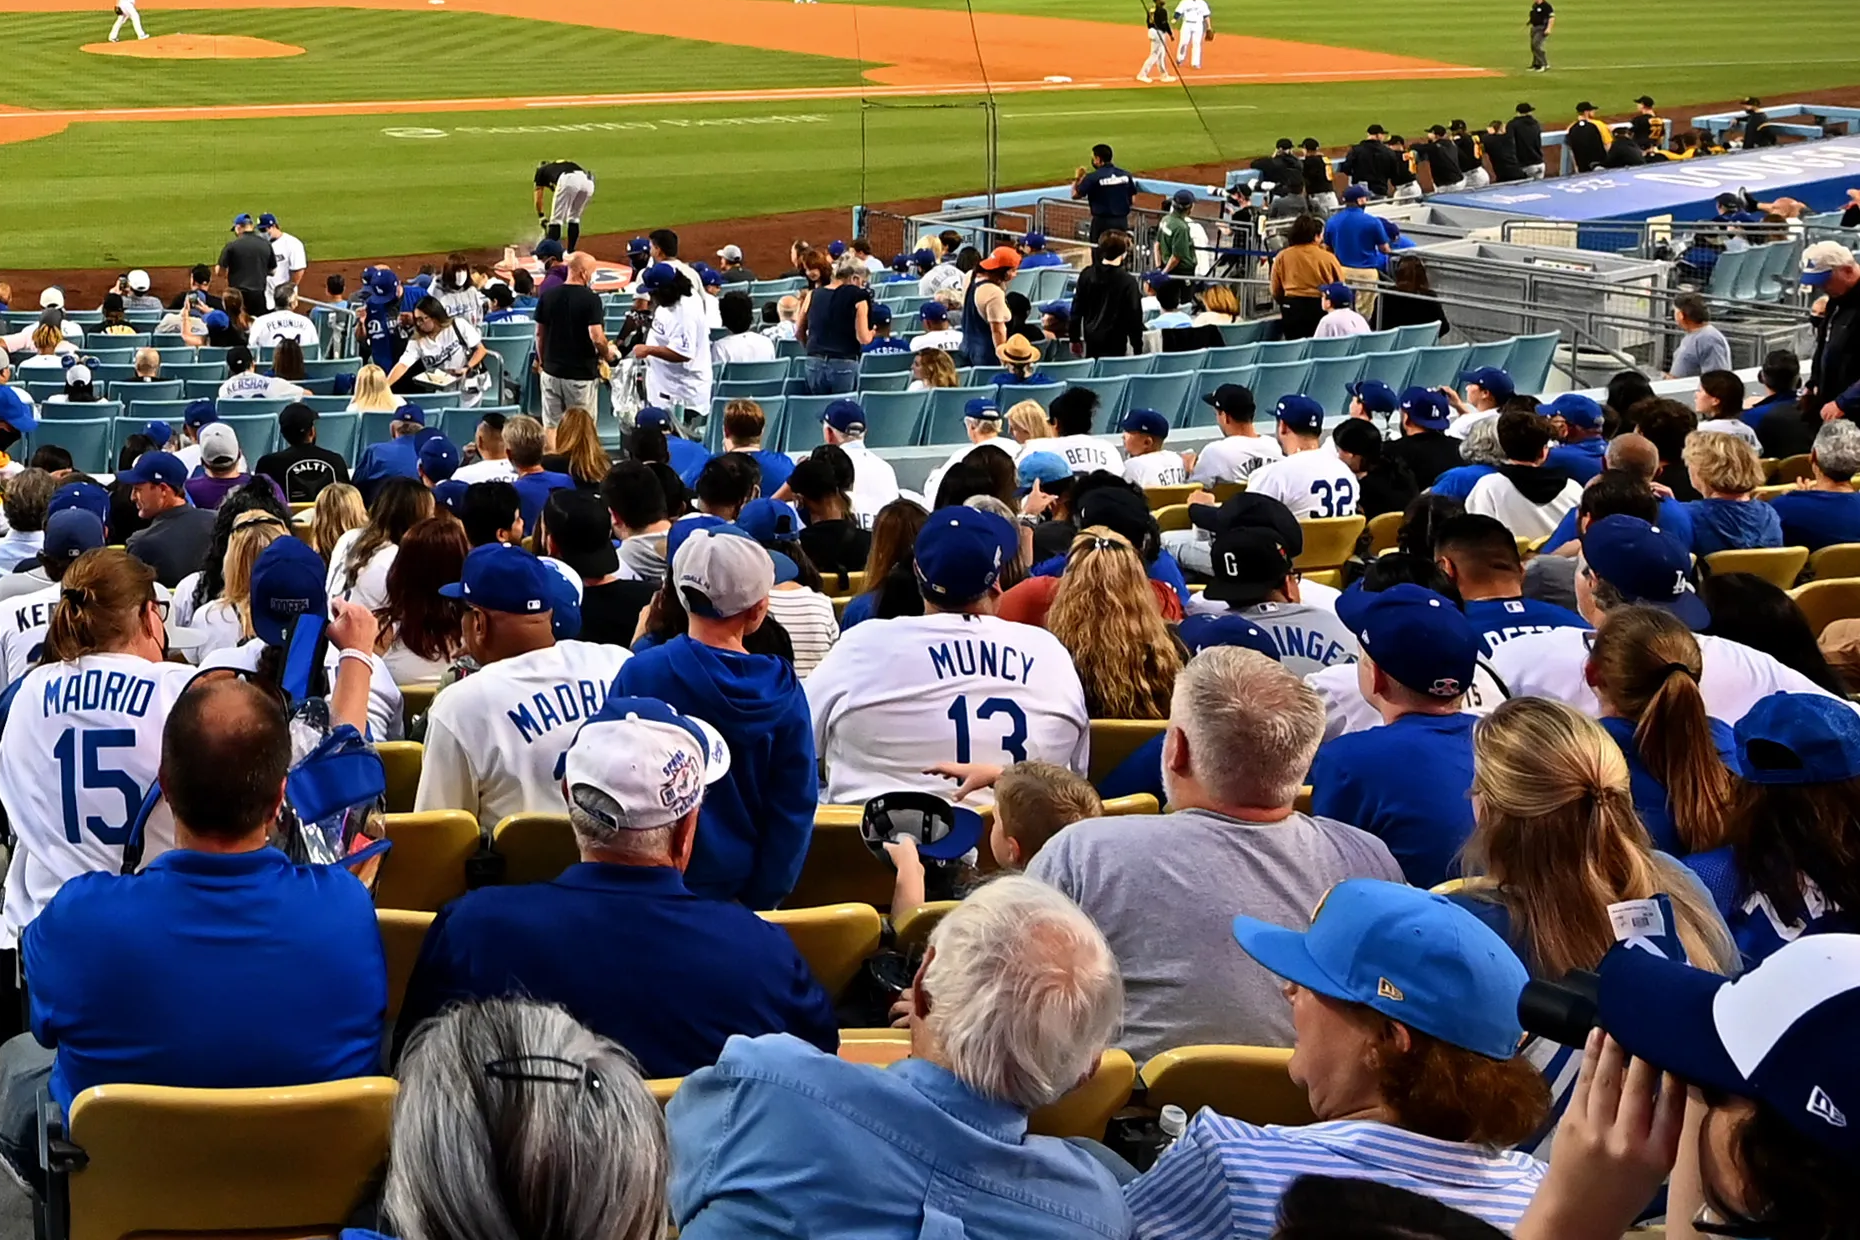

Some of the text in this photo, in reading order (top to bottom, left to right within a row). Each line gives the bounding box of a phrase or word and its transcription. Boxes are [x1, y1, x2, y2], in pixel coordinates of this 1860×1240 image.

[424, 341, 461, 368] Dodgers
[226, 379, 269, 394] KERSHAW
[292, 461, 328, 475] SALTY
[1065, 448, 1108, 465] BETTS
[1310, 477, 1353, 518] 32
[1223, 552, 1239, 576] G
[928, 639, 1035, 684] MUNCY
[43, 669, 156, 718] MADRID
[947, 694, 1028, 766] 13
[53, 727, 142, 845] 15
